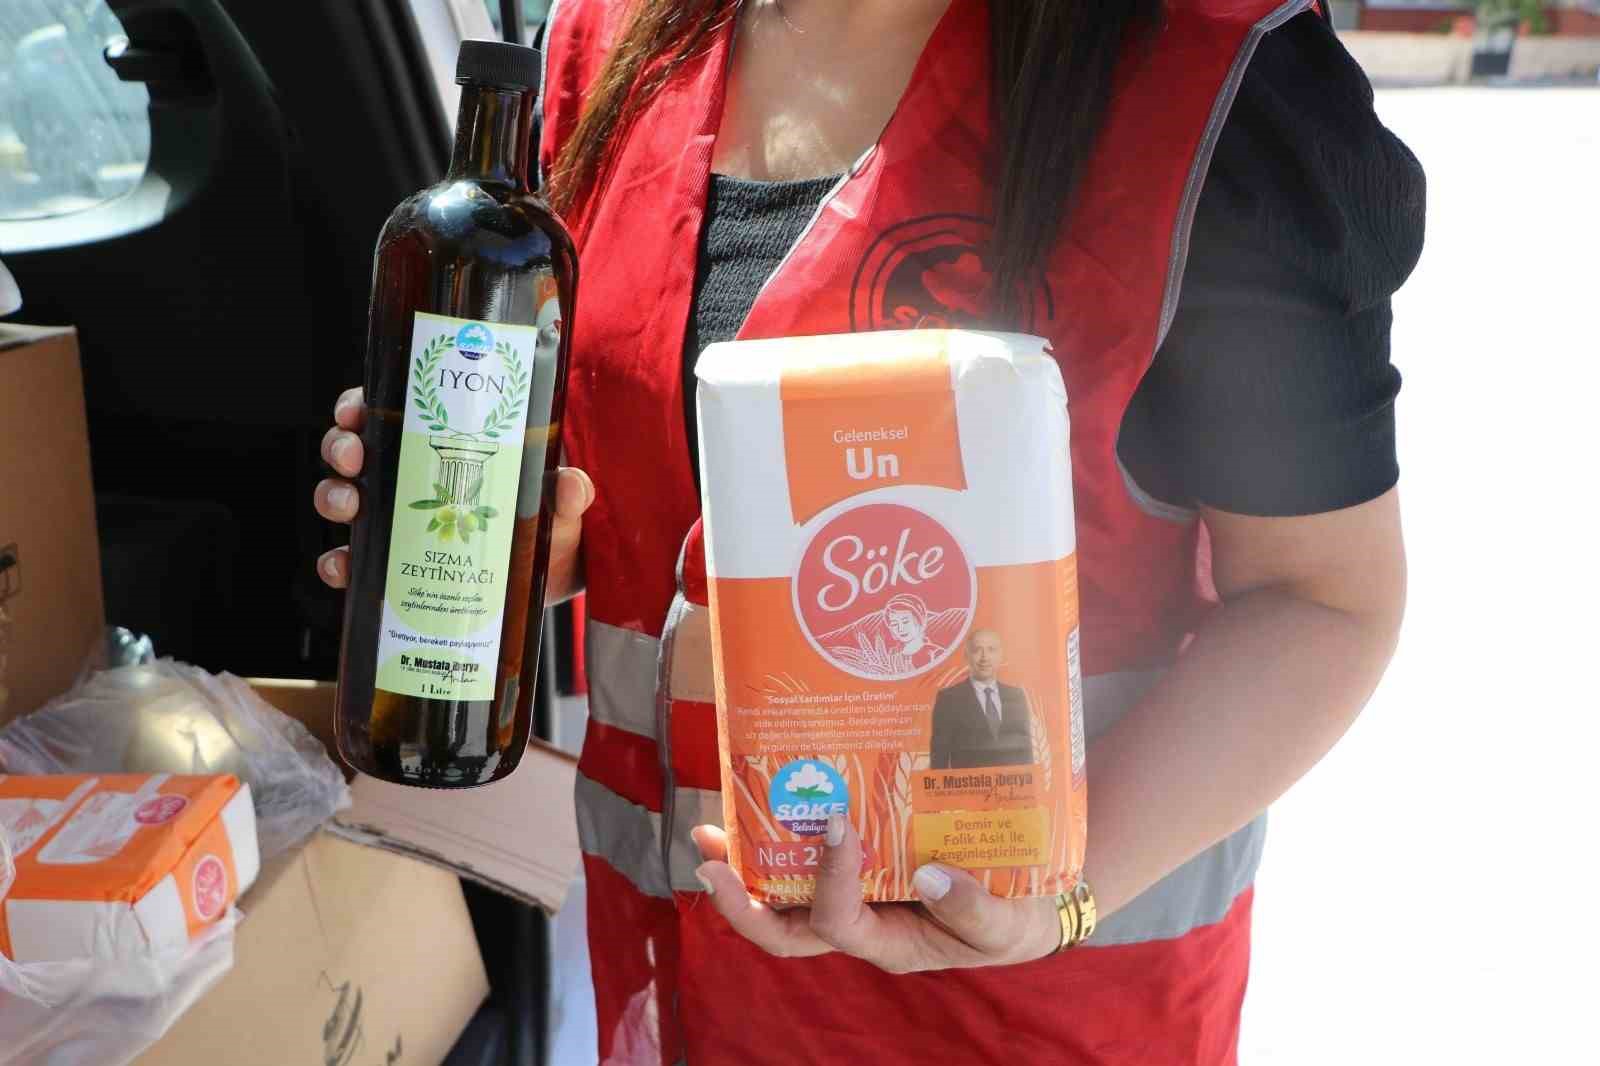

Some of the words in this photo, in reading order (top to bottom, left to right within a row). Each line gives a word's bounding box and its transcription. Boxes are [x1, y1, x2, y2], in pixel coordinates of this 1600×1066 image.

[439, 368, 506, 394] IYON
[833, 424, 909, 443] Geleneksel
[846, 447, 899, 480] Un
[425, 550, 472, 567] SIZMA
[401, 563, 494, 584] ZEYTİNYAĞI
[816, 528, 945, 612] Söke
[401, 655, 412, 668] Dr.
[923, 776, 940, 790] Dr.
[954, 818, 993, 832] Demir
[997, 817, 1012, 830] ve
[943, 833, 976, 847] Folik
[758, 846, 799, 867] Net
